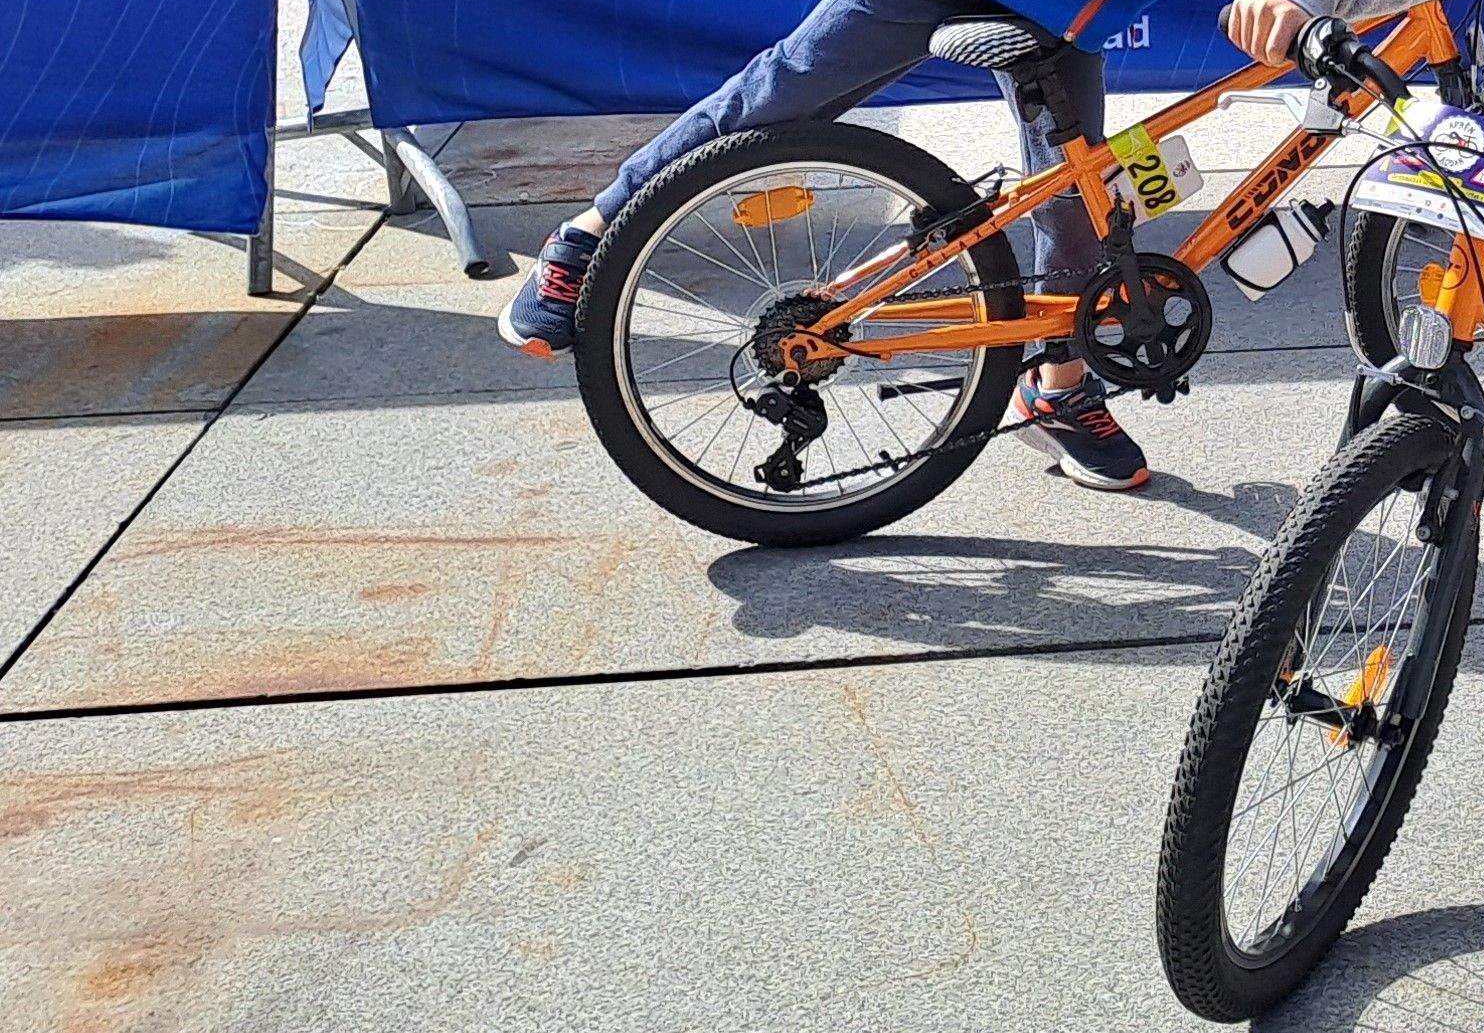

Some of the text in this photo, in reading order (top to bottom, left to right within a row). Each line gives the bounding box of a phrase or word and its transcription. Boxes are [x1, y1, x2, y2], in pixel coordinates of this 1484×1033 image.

[1127, 154, 1177, 210] 208
[1225, 132, 1329, 231] CONO
[908, 220, 997, 279] GALAXY
